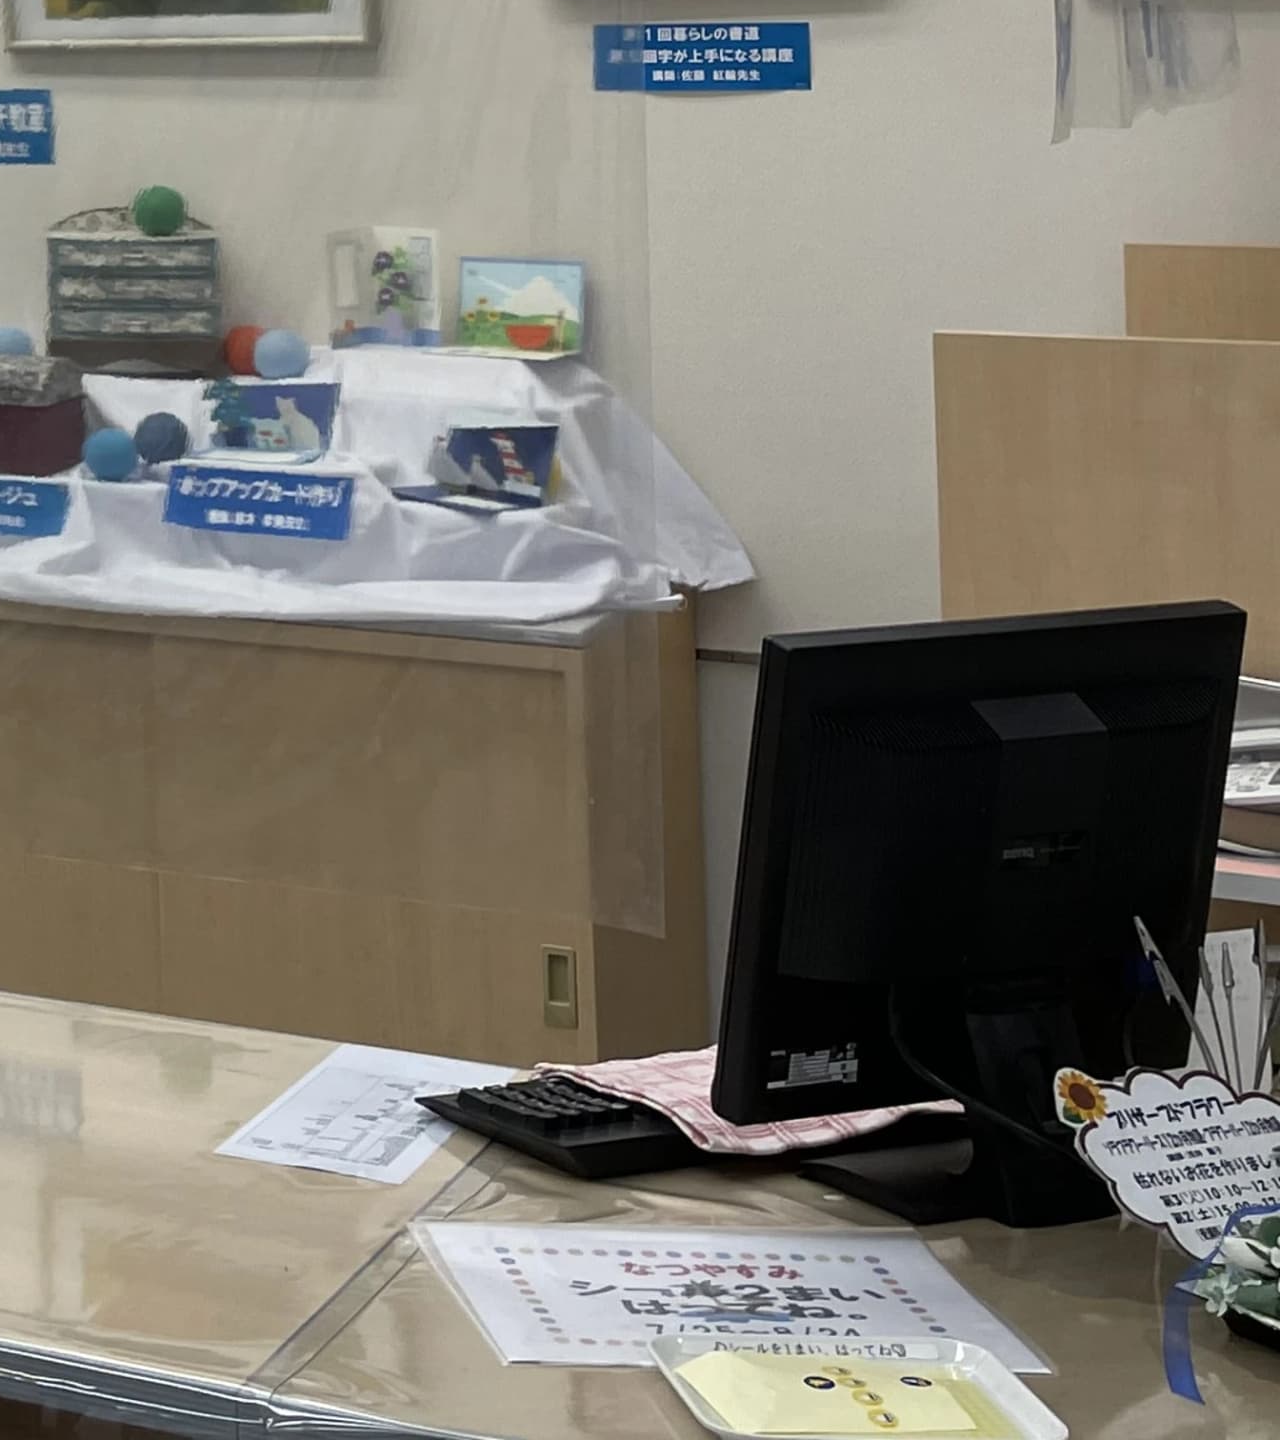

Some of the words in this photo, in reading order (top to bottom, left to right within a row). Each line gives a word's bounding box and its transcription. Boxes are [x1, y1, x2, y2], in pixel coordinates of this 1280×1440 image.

[609, 48, 795, 64] 回字が上手になる講座
[619, 1262, 804, 1279] なつやすみ
[569, 1278, 886, 1303] シー2まい
